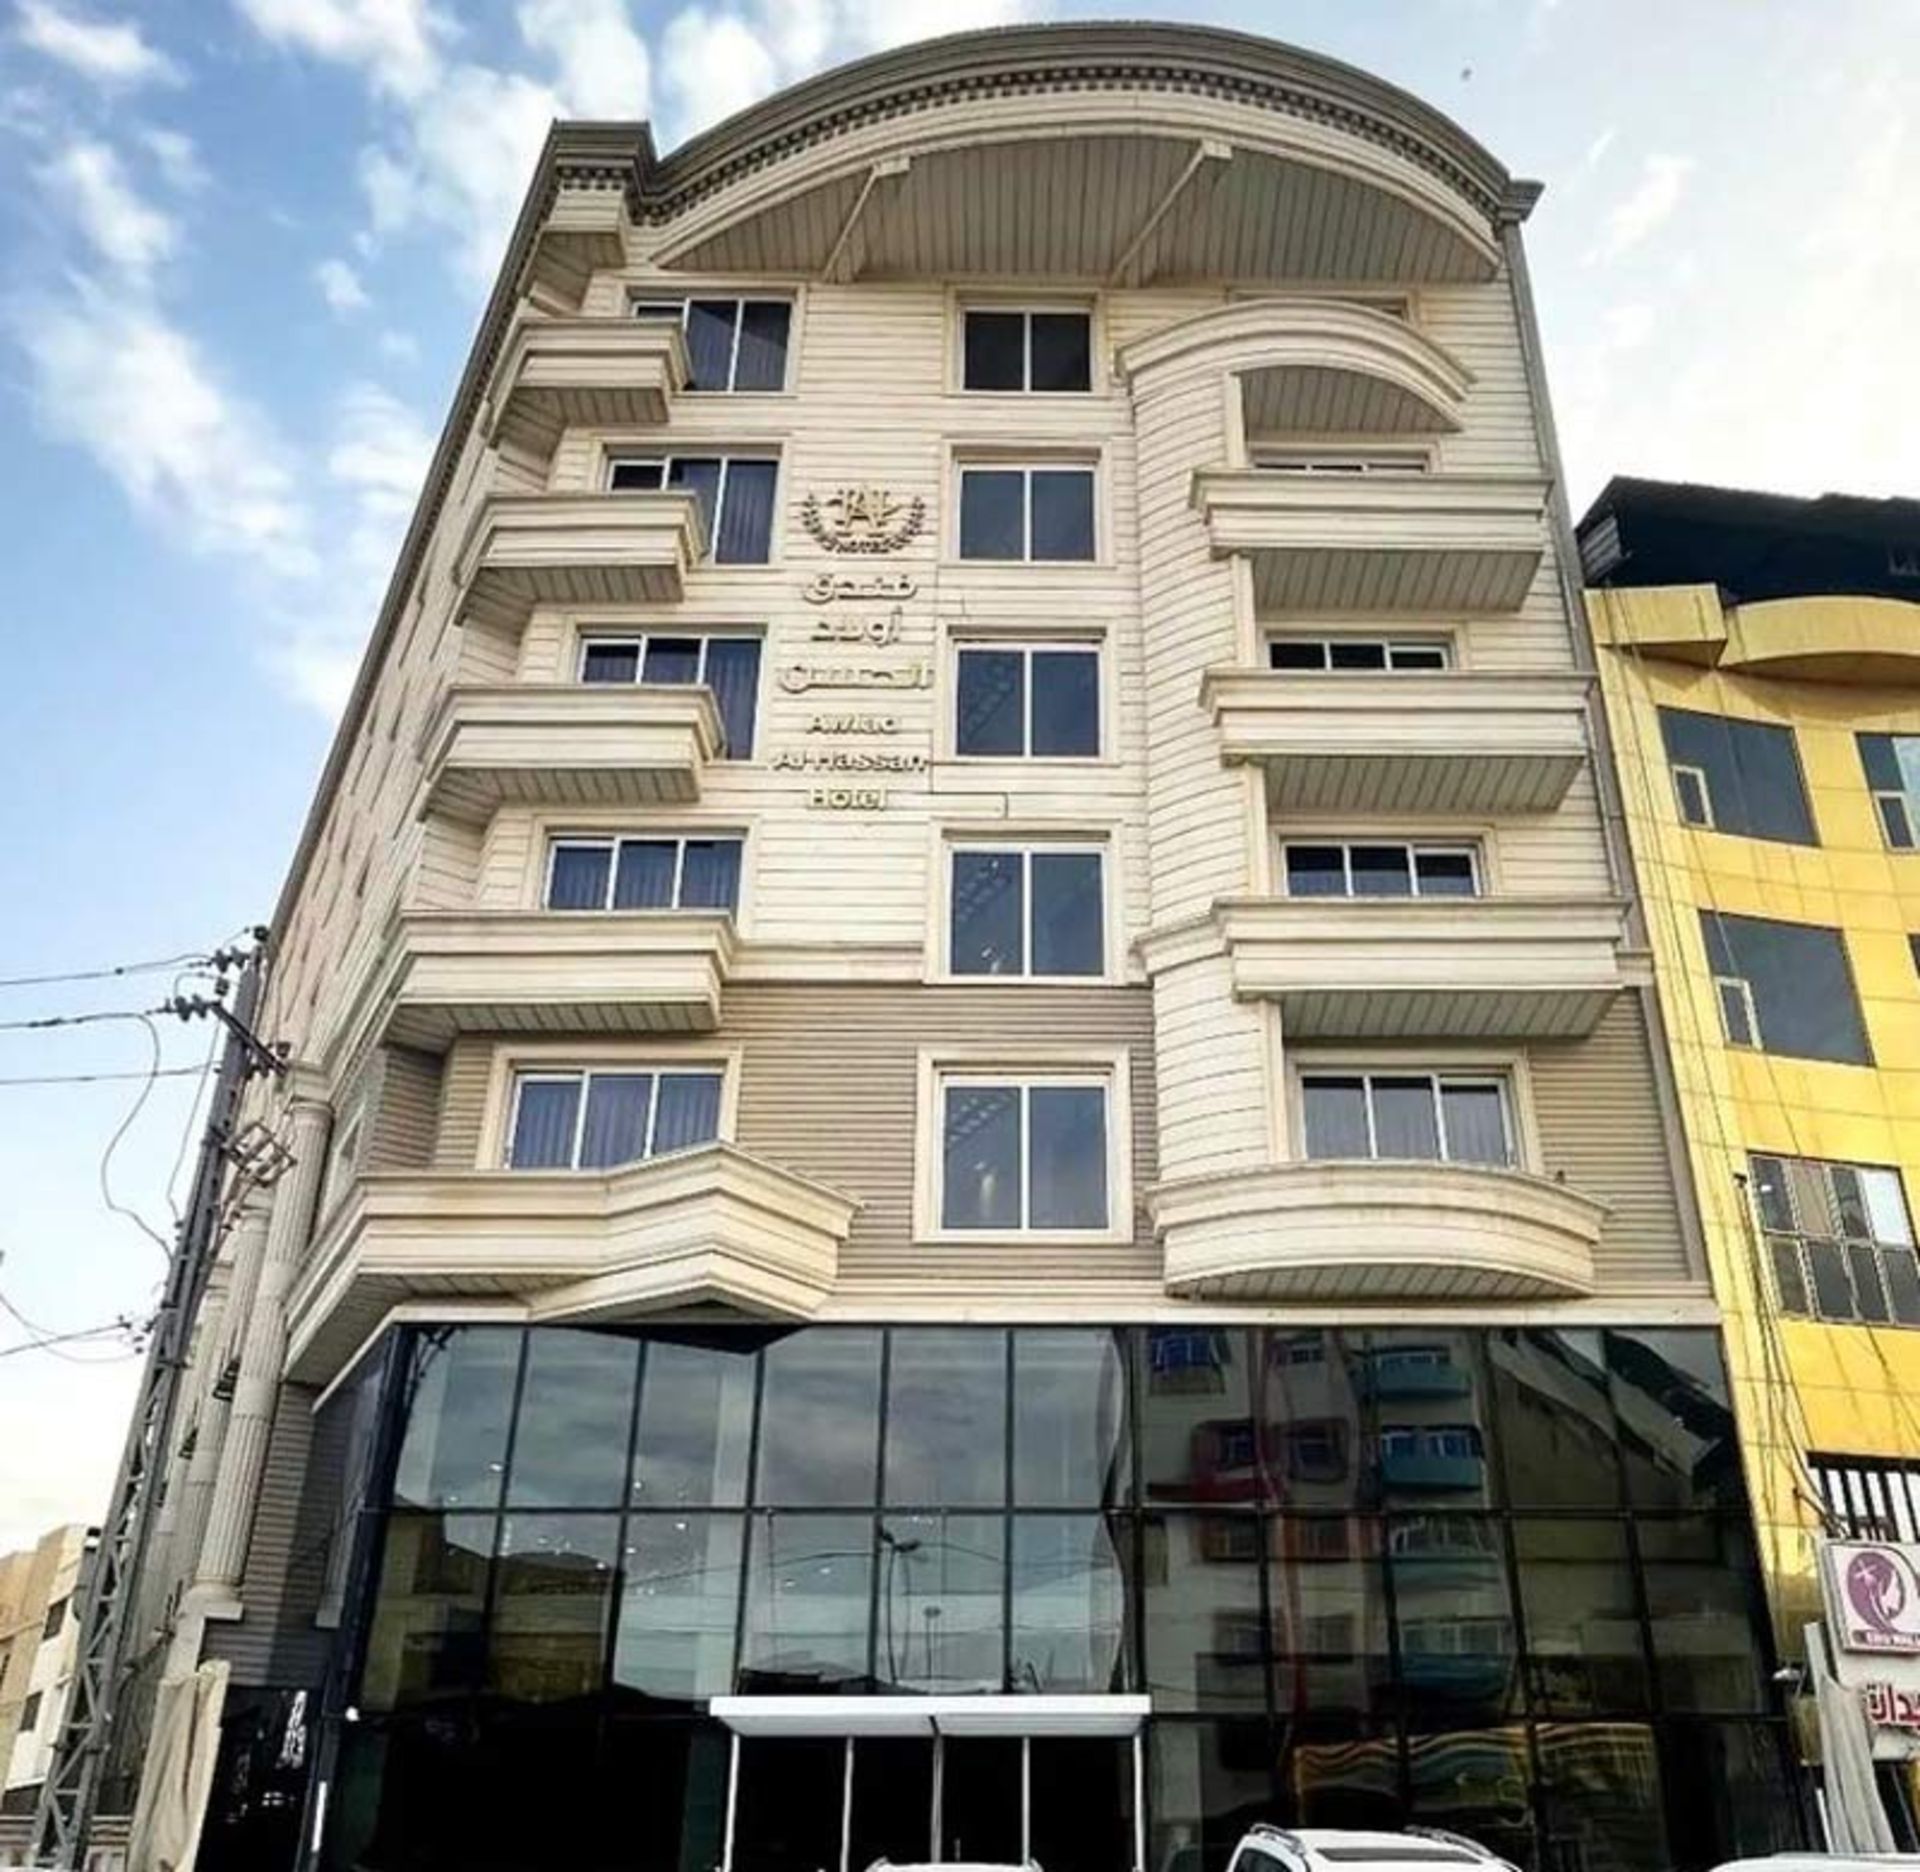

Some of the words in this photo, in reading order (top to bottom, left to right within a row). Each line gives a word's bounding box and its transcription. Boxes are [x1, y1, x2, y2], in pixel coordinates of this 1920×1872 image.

[803, 573, 918, 605] فندق
[773, 751, 928, 773] Al-Hassan
[808, 785, 887, 811] Hotel
